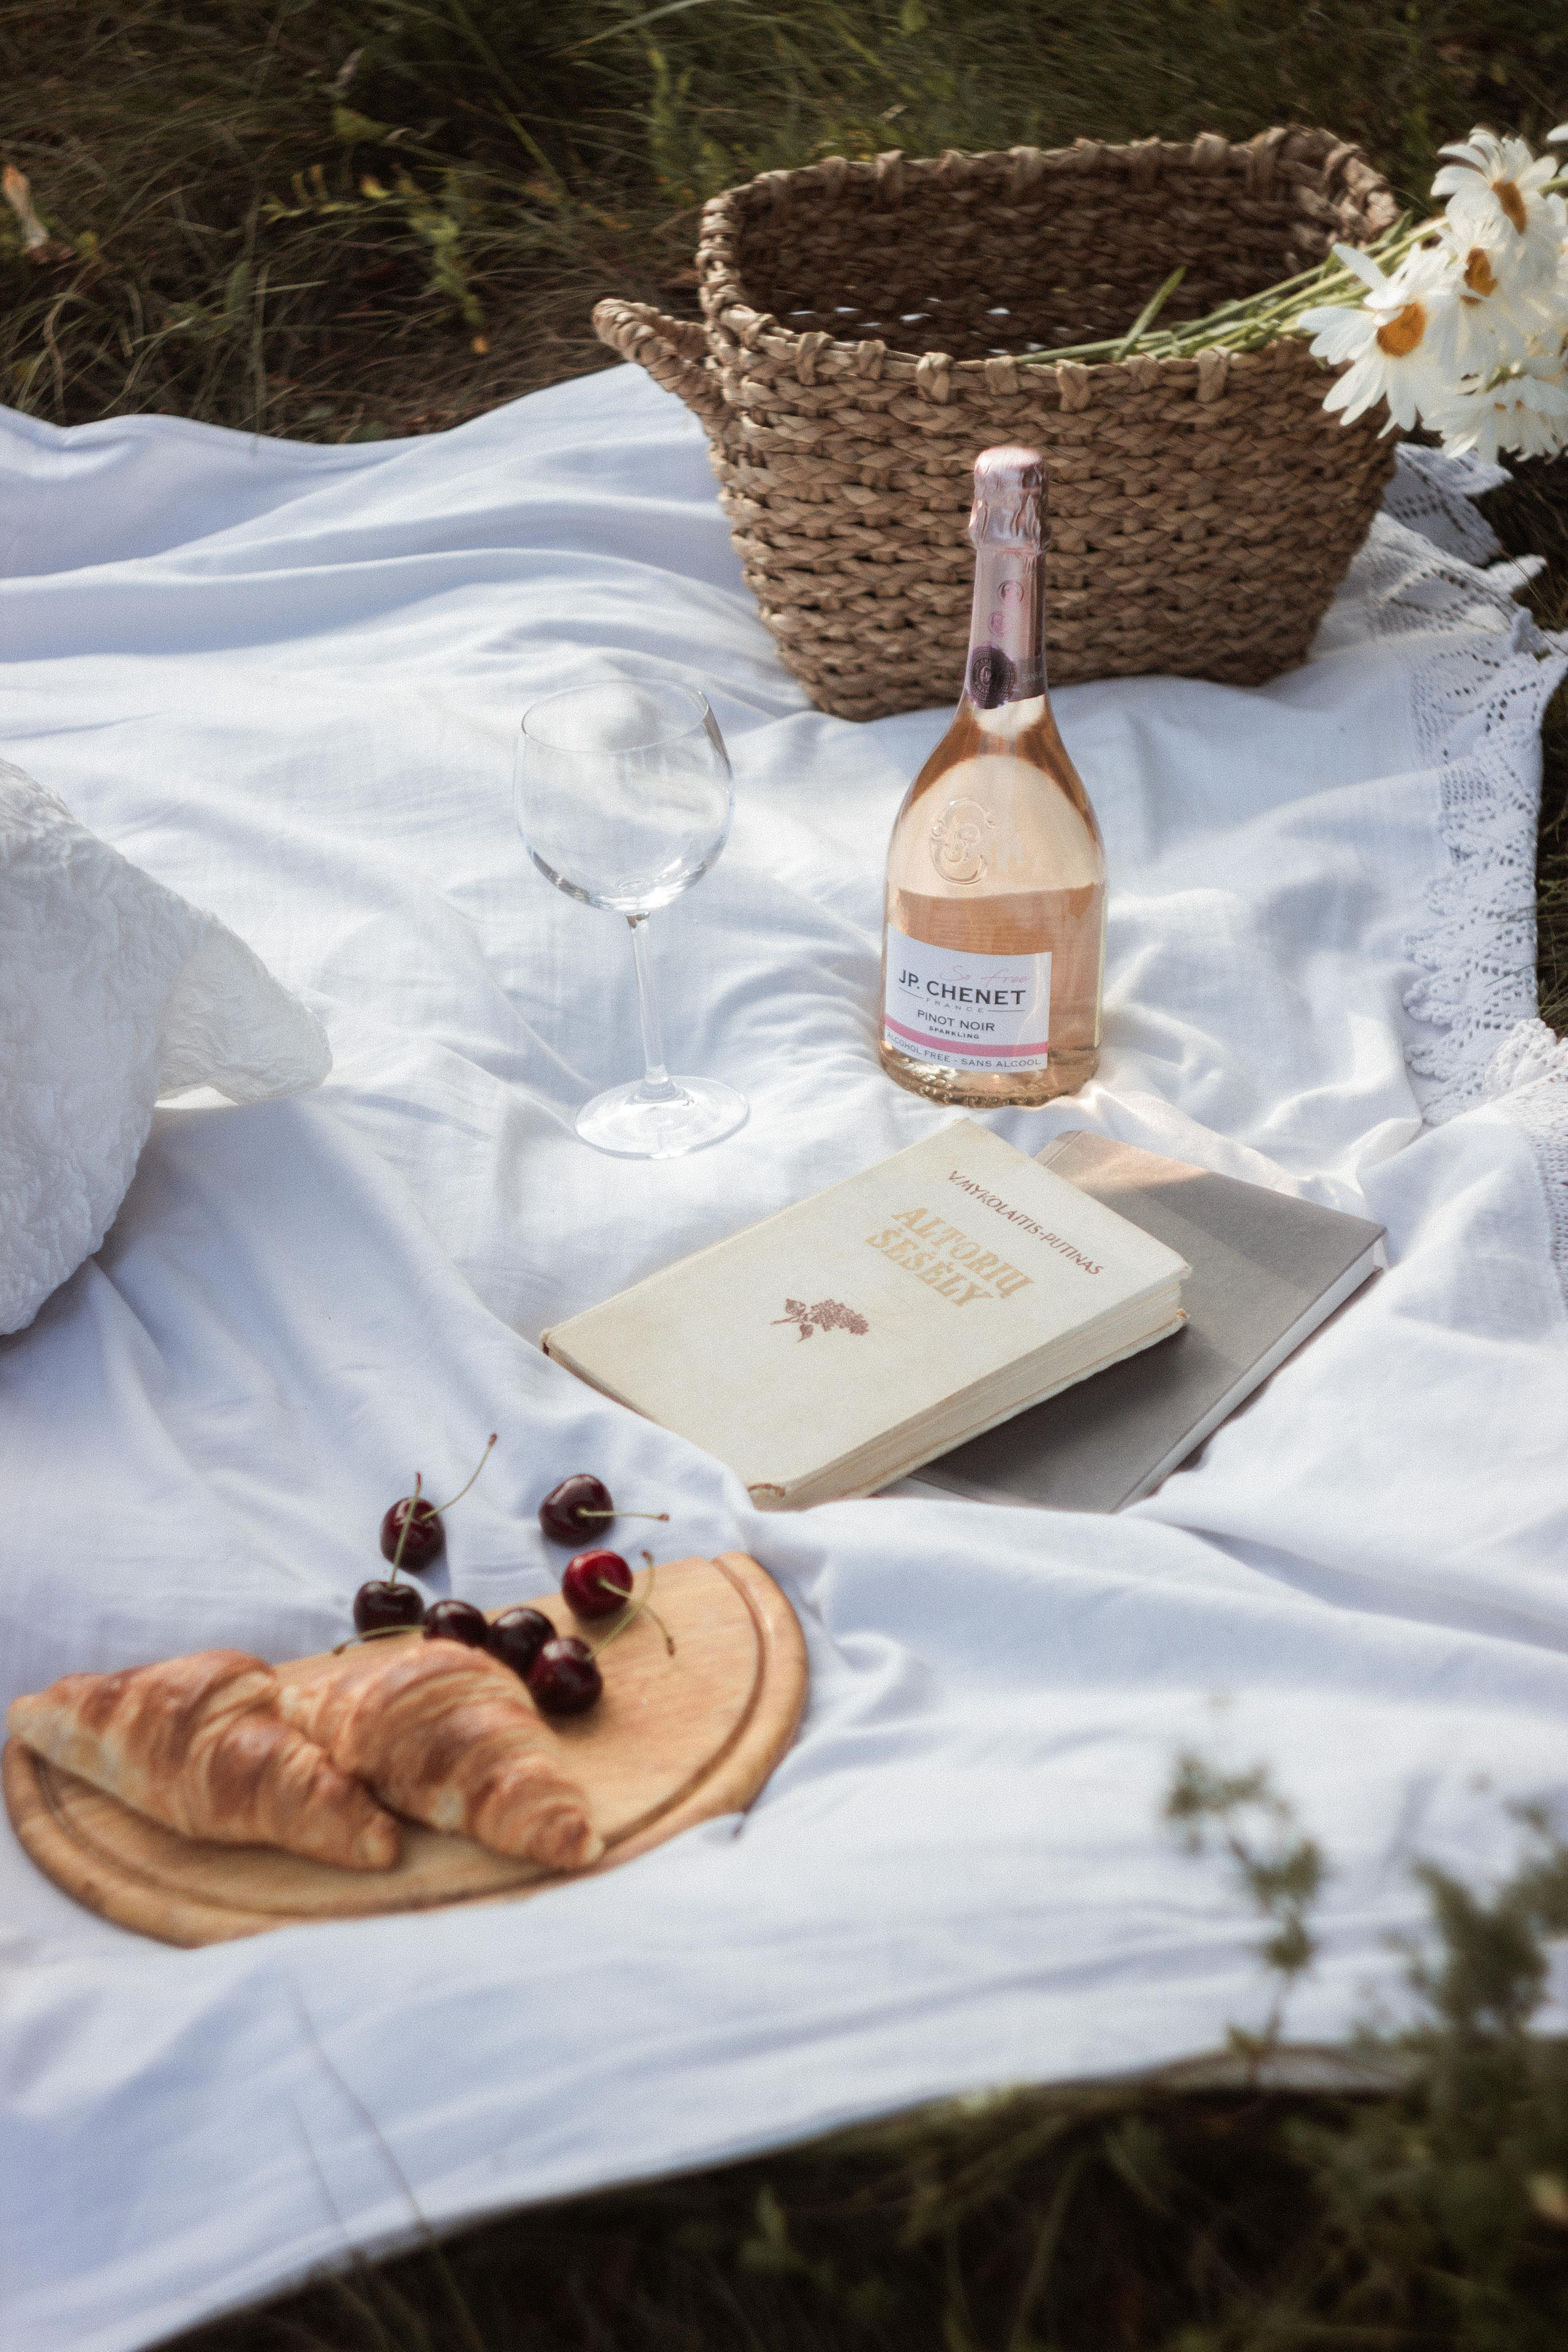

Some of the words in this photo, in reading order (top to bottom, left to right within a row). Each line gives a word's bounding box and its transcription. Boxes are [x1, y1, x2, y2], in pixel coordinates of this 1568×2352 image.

[926, 980, 1027, 1005] CHENET
[926, 997, 984, 1013] FRANCE
[917, 1009, 956, 1027] PINOT
[959, 1019, 995, 1031] NOIR
[929, 1025, 979, 1039] SPARKLING
[887, 1031, 922, 1055] ALCOHOL
[924, 1049, 951, 1063] FREE
[960, 1058, 992, 1067] SANS
[995, 1058, 1042, 1068] ALCOOL
